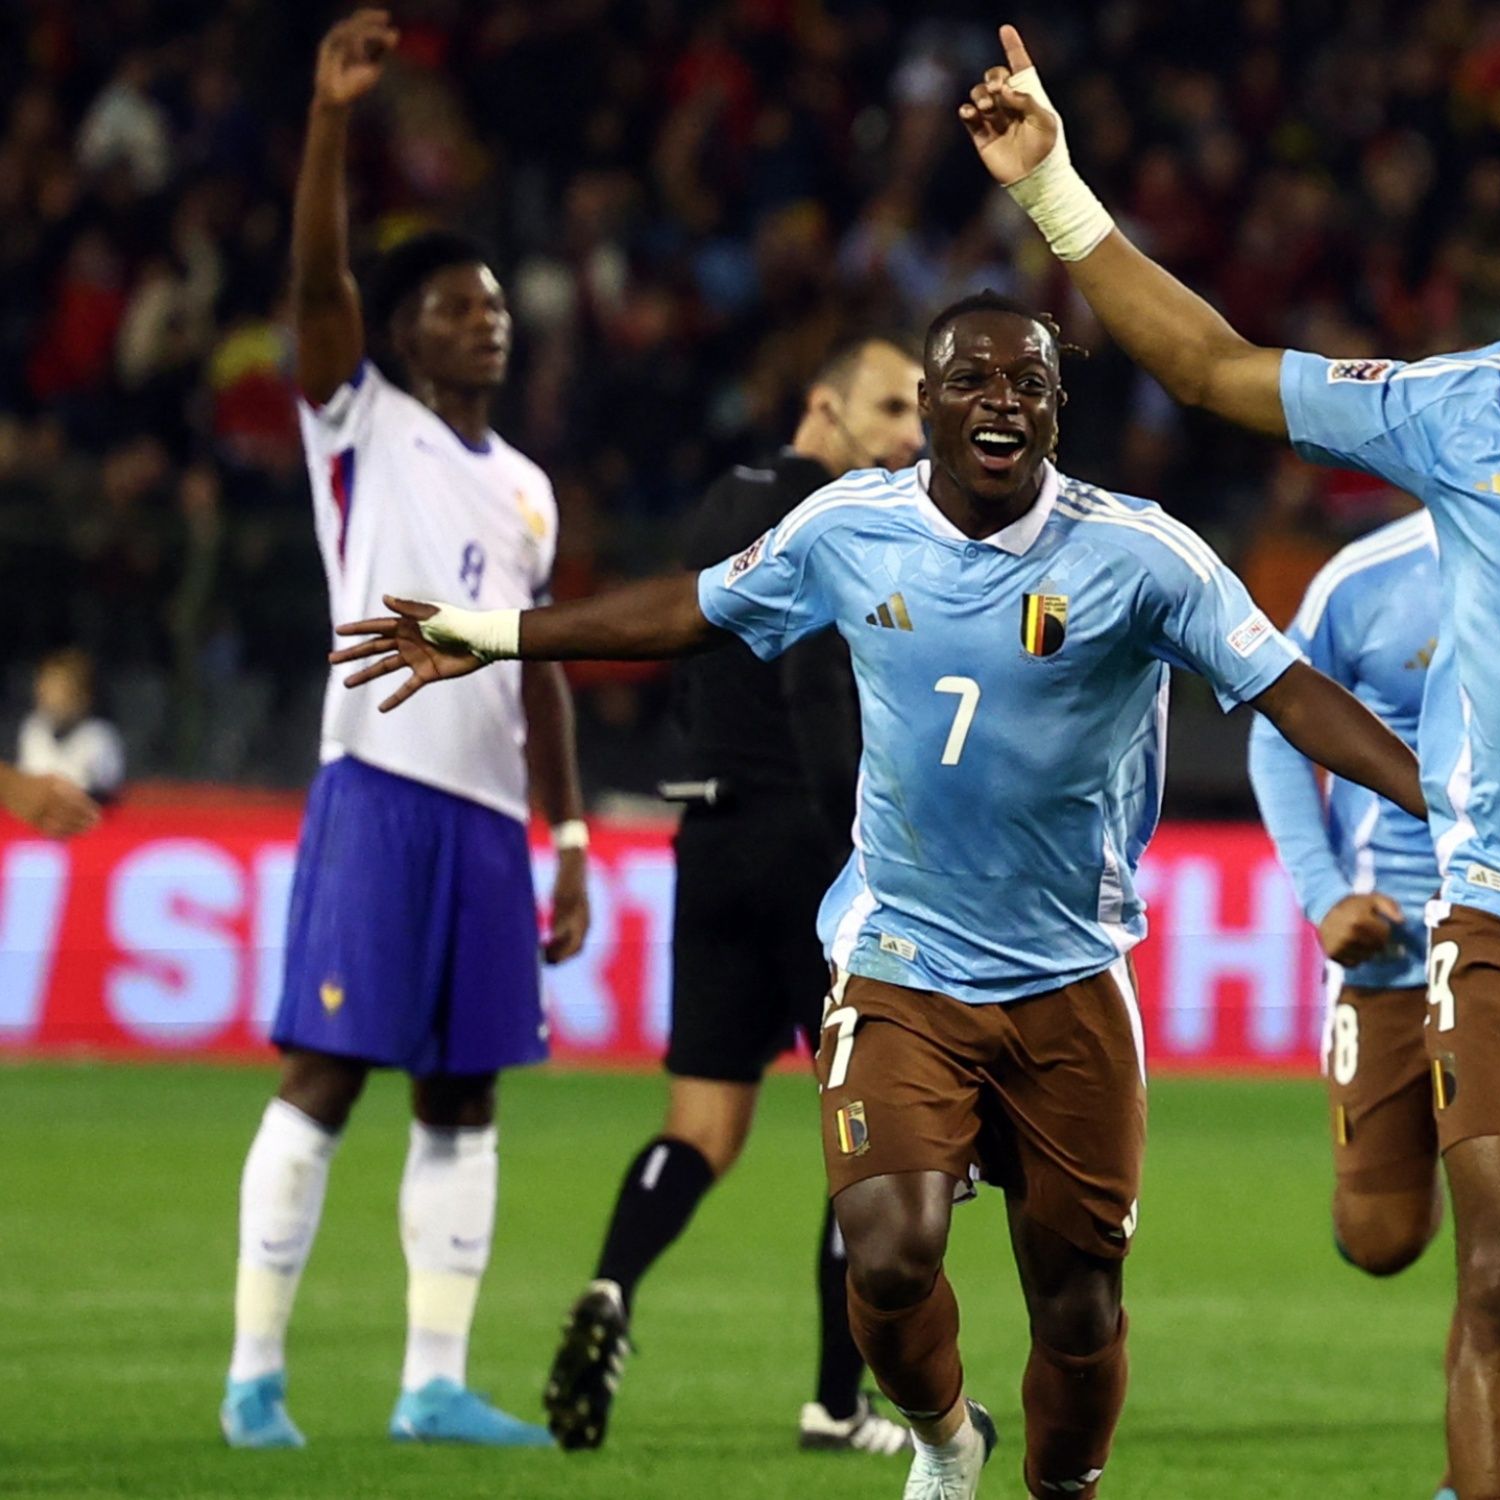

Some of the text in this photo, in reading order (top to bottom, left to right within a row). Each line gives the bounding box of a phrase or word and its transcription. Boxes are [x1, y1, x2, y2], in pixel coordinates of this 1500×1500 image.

[459, 541, 485, 601] 8
[933, 675, 981, 766] 7
[1429, 941, 1459, 1032] 9
[823, 1006, 858, 1089] 7
[1334, 1003, 1358, 1086] 8
